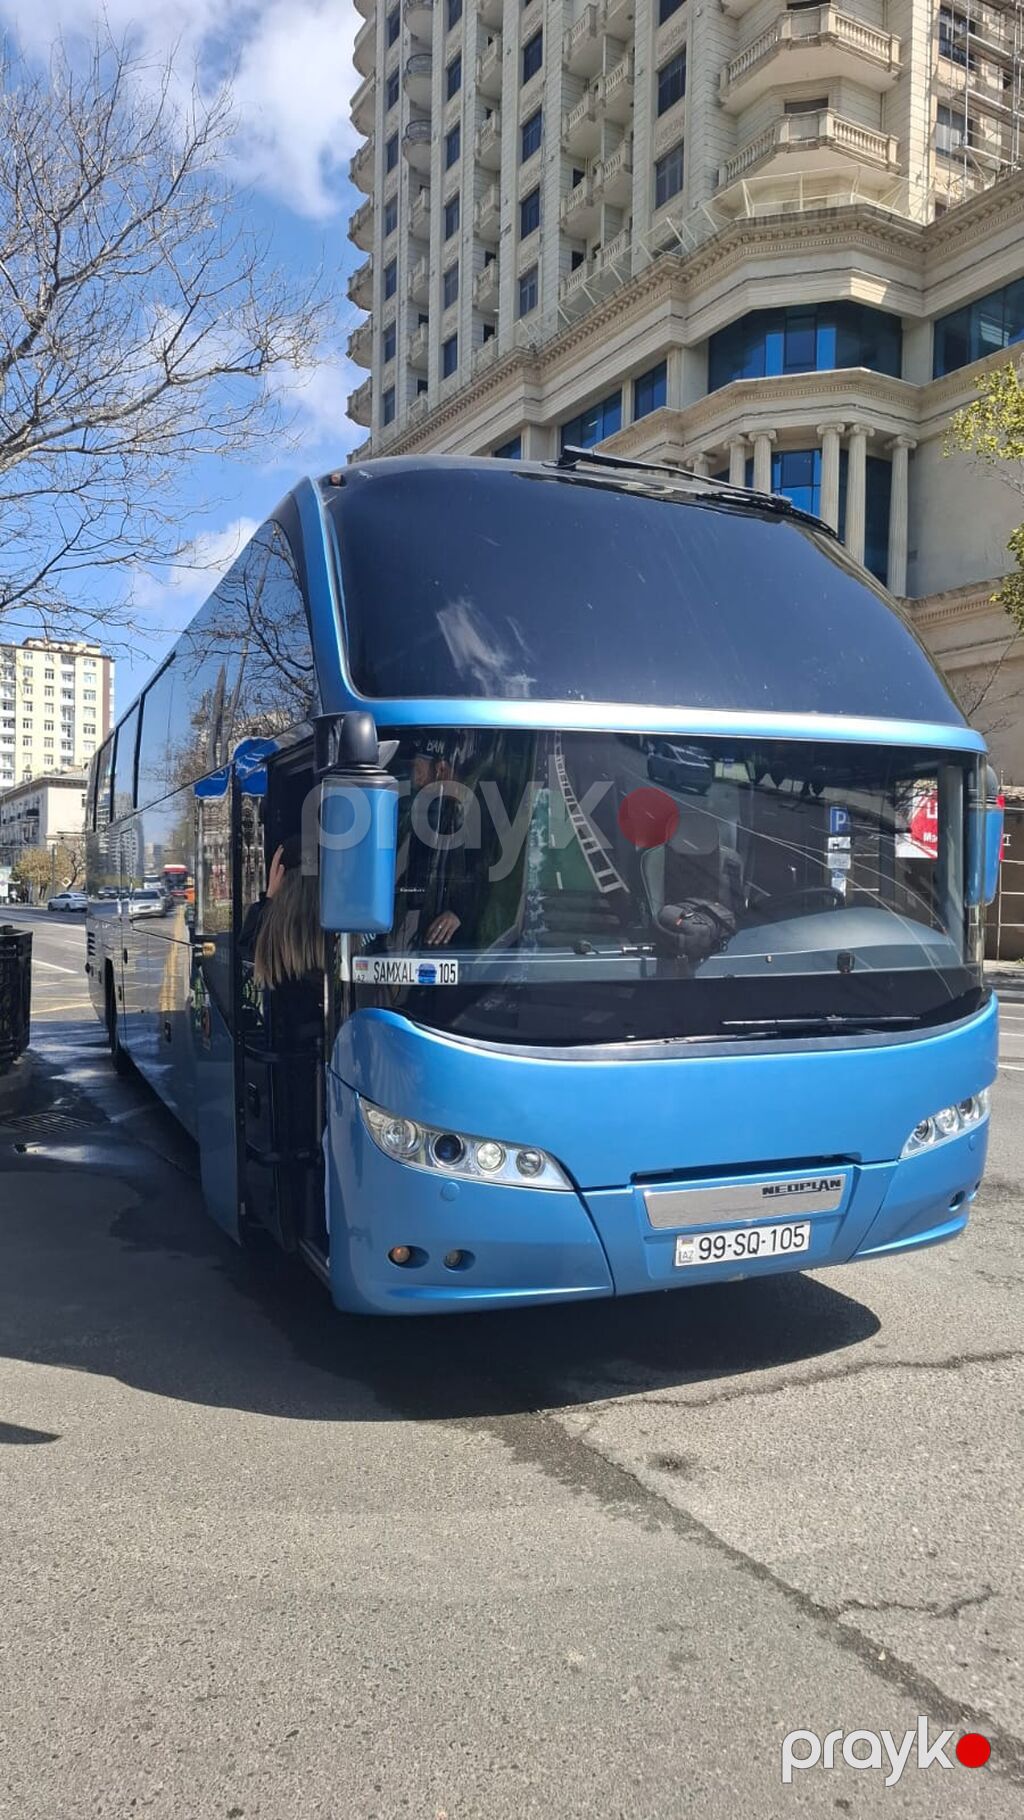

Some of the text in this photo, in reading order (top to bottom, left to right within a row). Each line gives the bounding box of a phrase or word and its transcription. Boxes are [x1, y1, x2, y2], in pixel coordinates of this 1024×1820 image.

[836, 810, 847, 831] P
[439, 962, 456, 983] 105
[762, 1179, 841, 1197] NEOPLAN
[698, 1224, 806, 1261] 99-SQ-105
[682, 1250, 694, 1260] AZ
